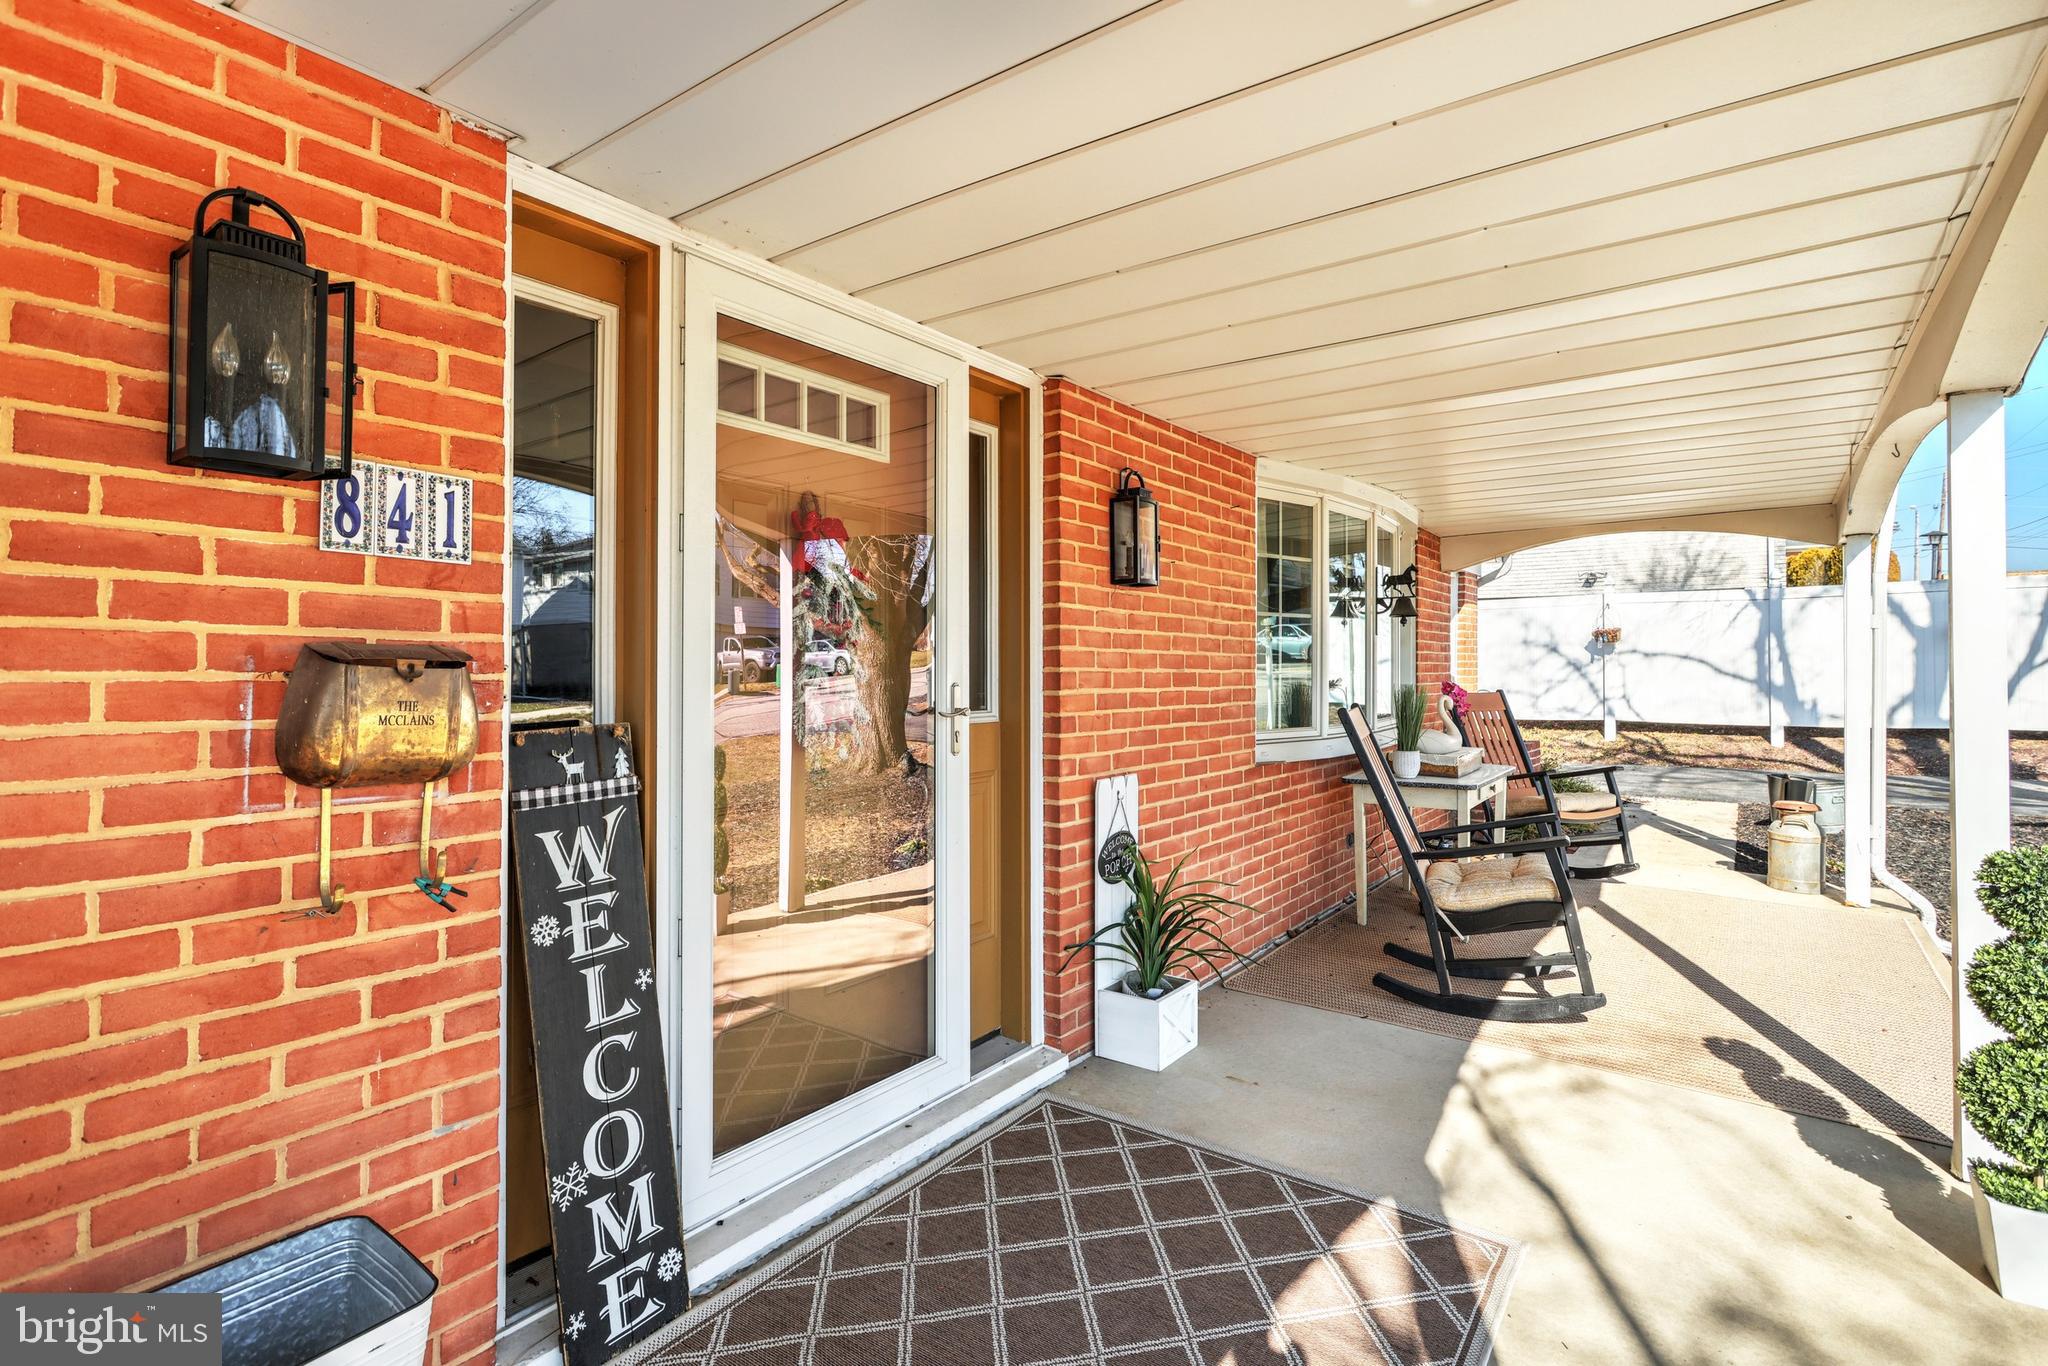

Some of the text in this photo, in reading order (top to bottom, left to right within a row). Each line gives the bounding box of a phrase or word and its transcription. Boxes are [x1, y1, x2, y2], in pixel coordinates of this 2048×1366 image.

[334, 474, 457, 549] 841
[397, 700, 419, 712] THE
[378, 714, 435, 726] MCCLAINS
[1101, 835, 1134, 859] WELCOME
[1104, 853, 1133, 877] PORCH
[534, 805, 666, 1346] WELCOME
